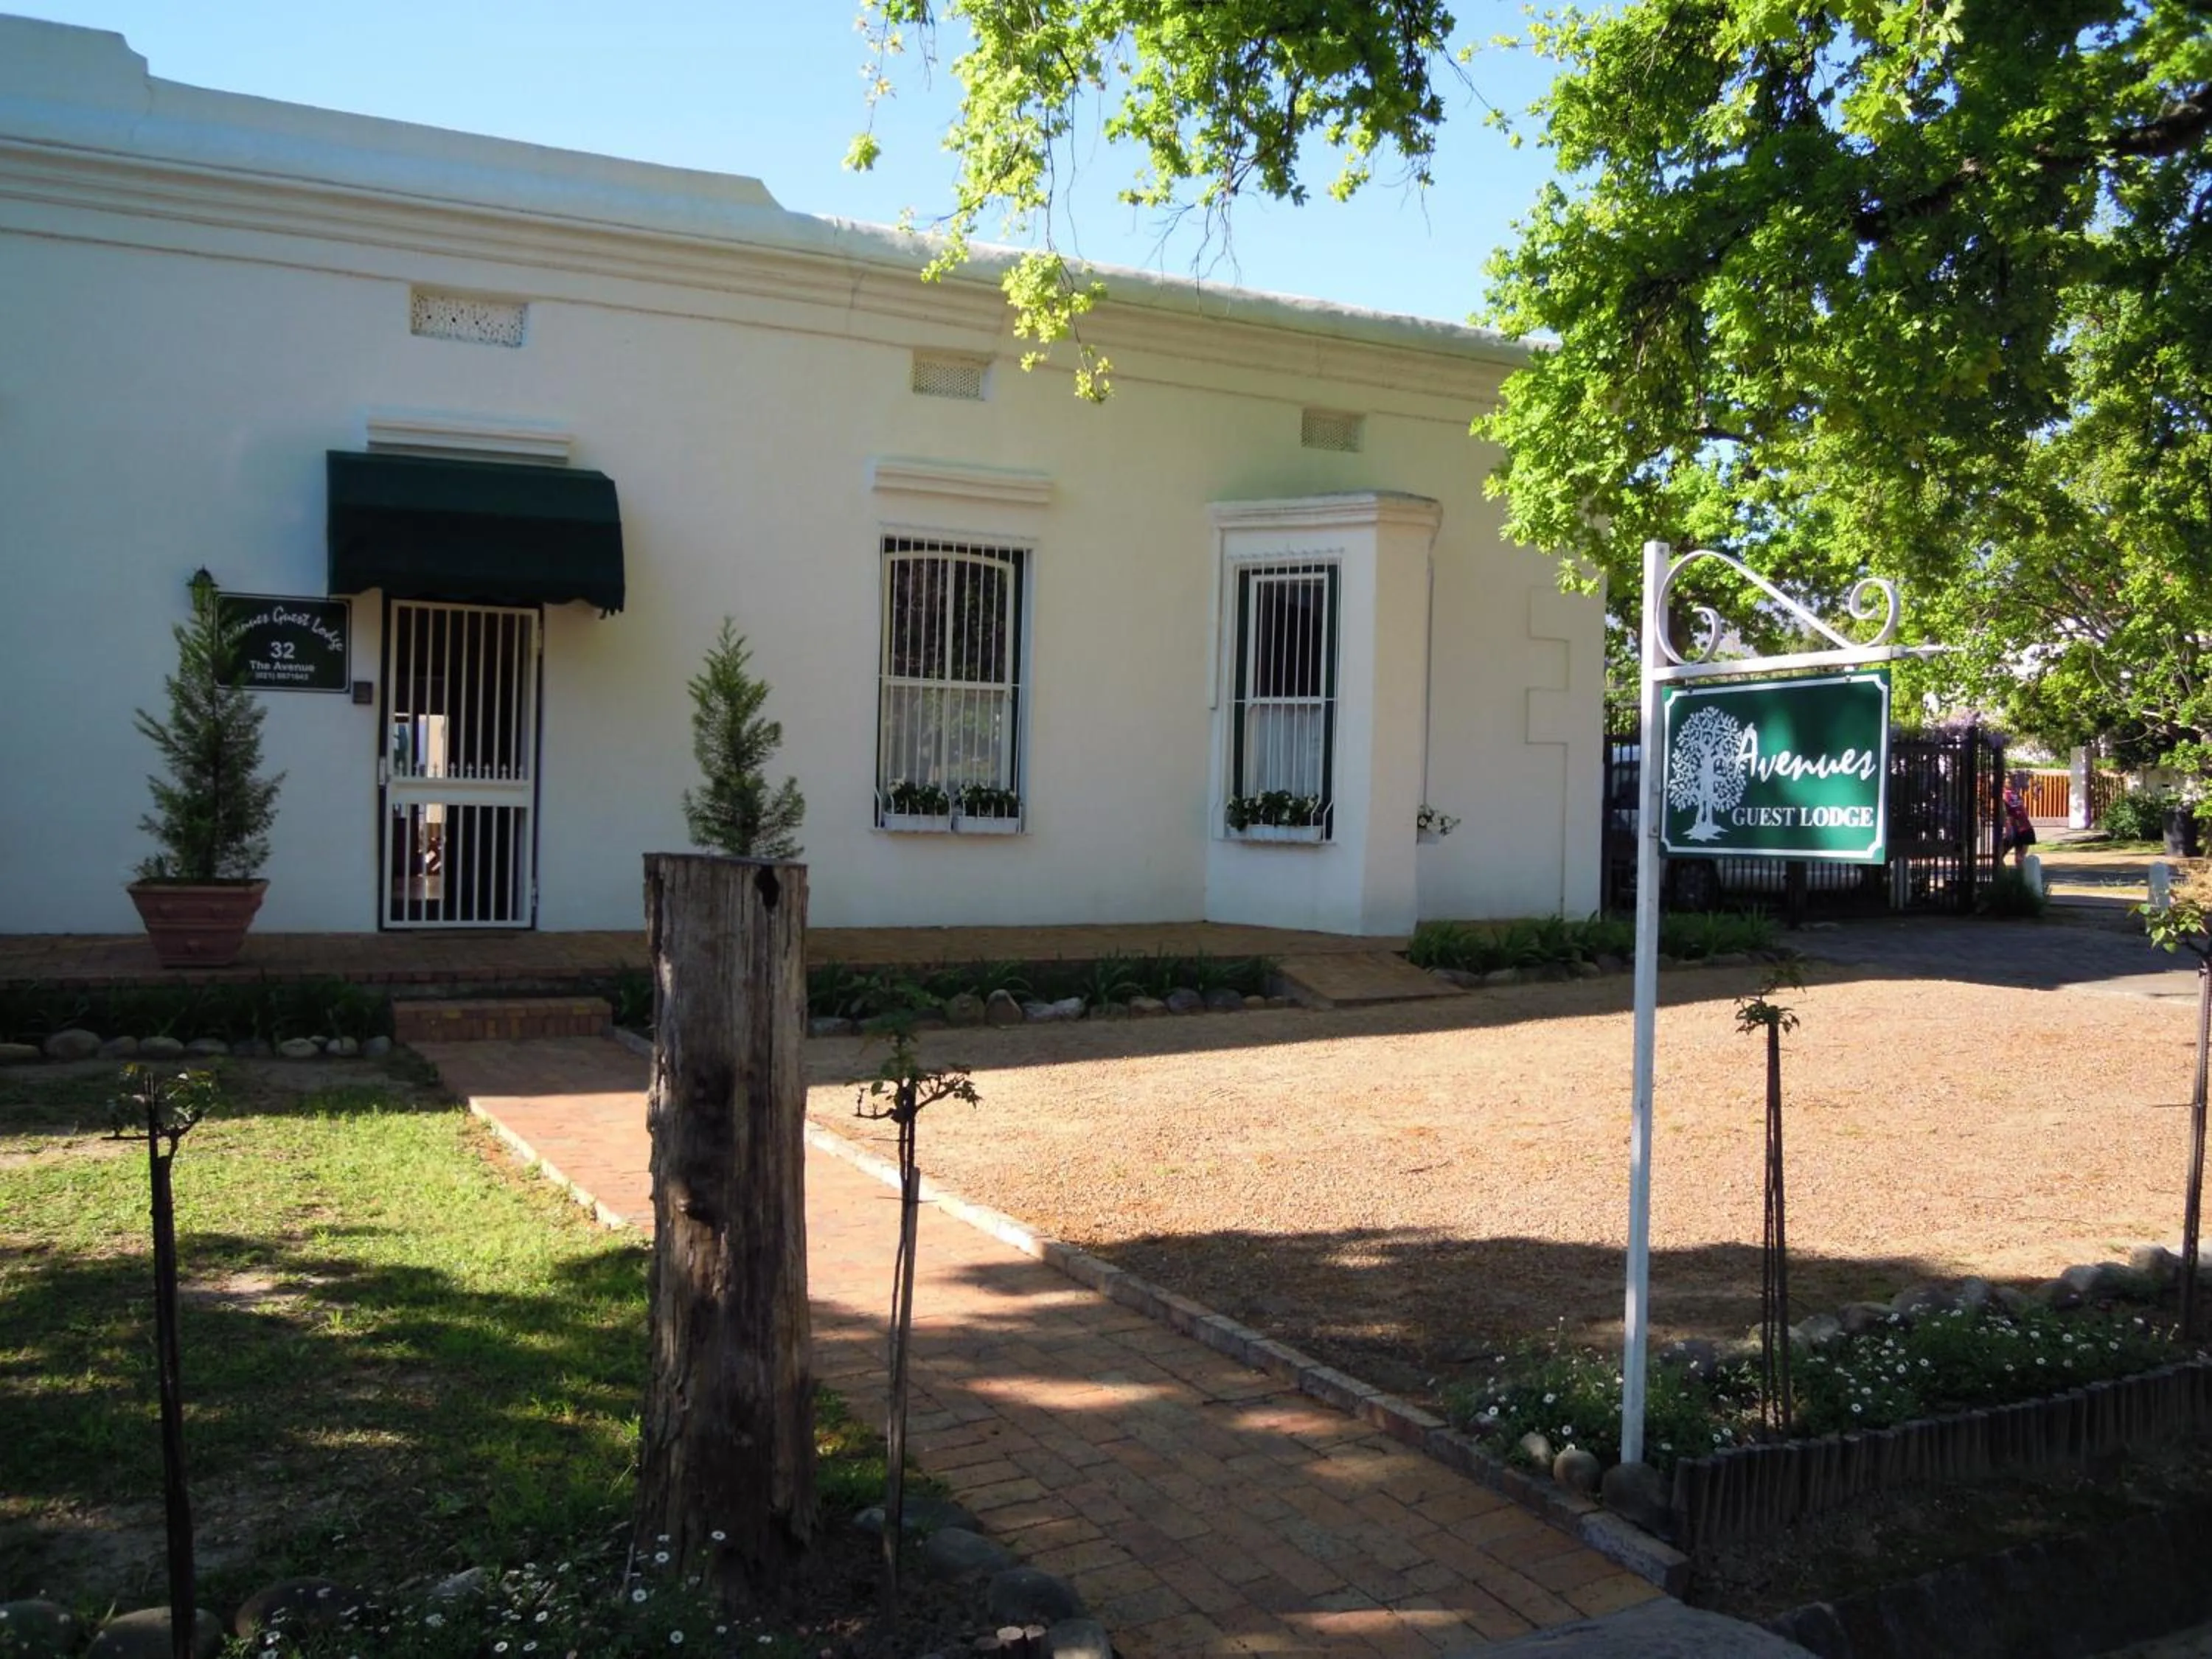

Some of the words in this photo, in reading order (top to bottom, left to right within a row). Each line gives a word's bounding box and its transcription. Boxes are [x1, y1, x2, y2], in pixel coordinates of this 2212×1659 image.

[272, 605, 311, 626] Guest
[312, 617, 344, 651] Lodge
[270, 641, 296, 659] 32
[248, 660, 270, 671] The
[272, 661, 316, 673] Avenue
[1735, 722, 1877, 782] Avenues
[1733, 807, 1798, 827] GUEST
[1800, 806, 1874, 827] LODGE
